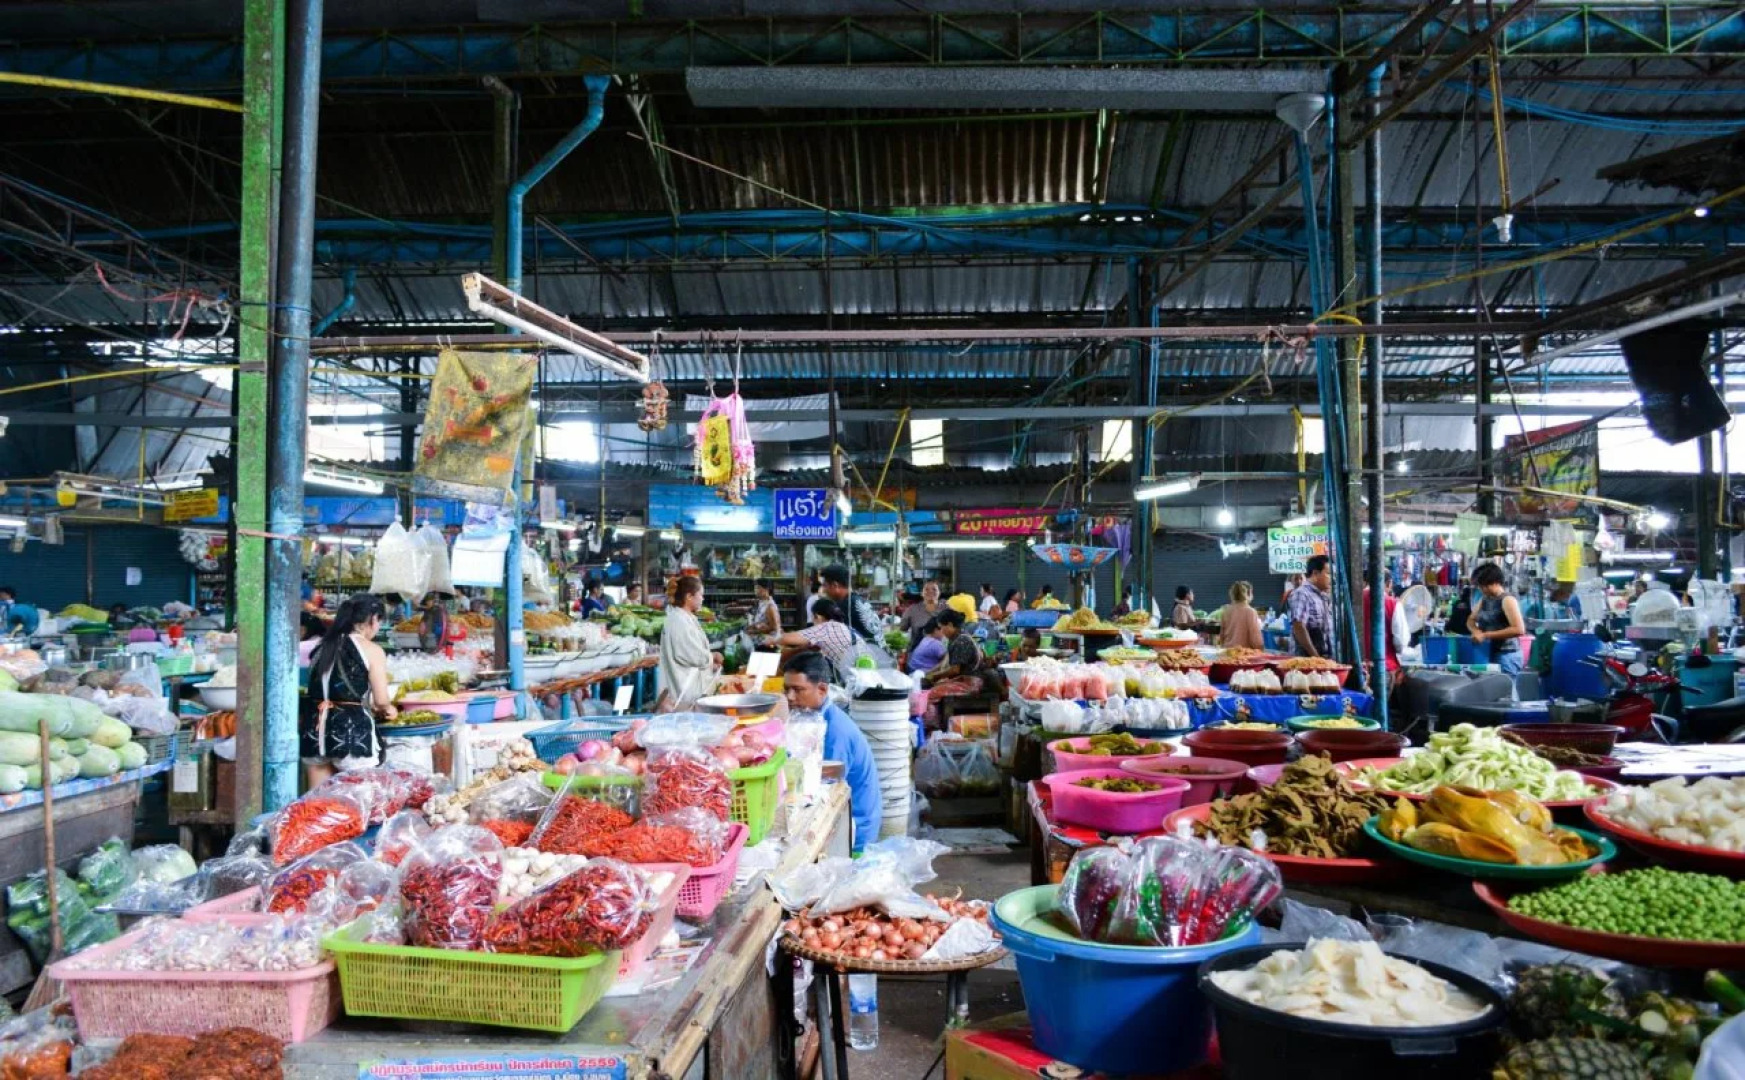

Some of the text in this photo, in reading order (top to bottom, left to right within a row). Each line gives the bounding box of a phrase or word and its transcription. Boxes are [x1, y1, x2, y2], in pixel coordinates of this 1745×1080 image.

[776, 520, 833, 537] เครื่องแกง
[959, 513, 982, 531] 20
[578, 1057, 617, 1069] 2559
